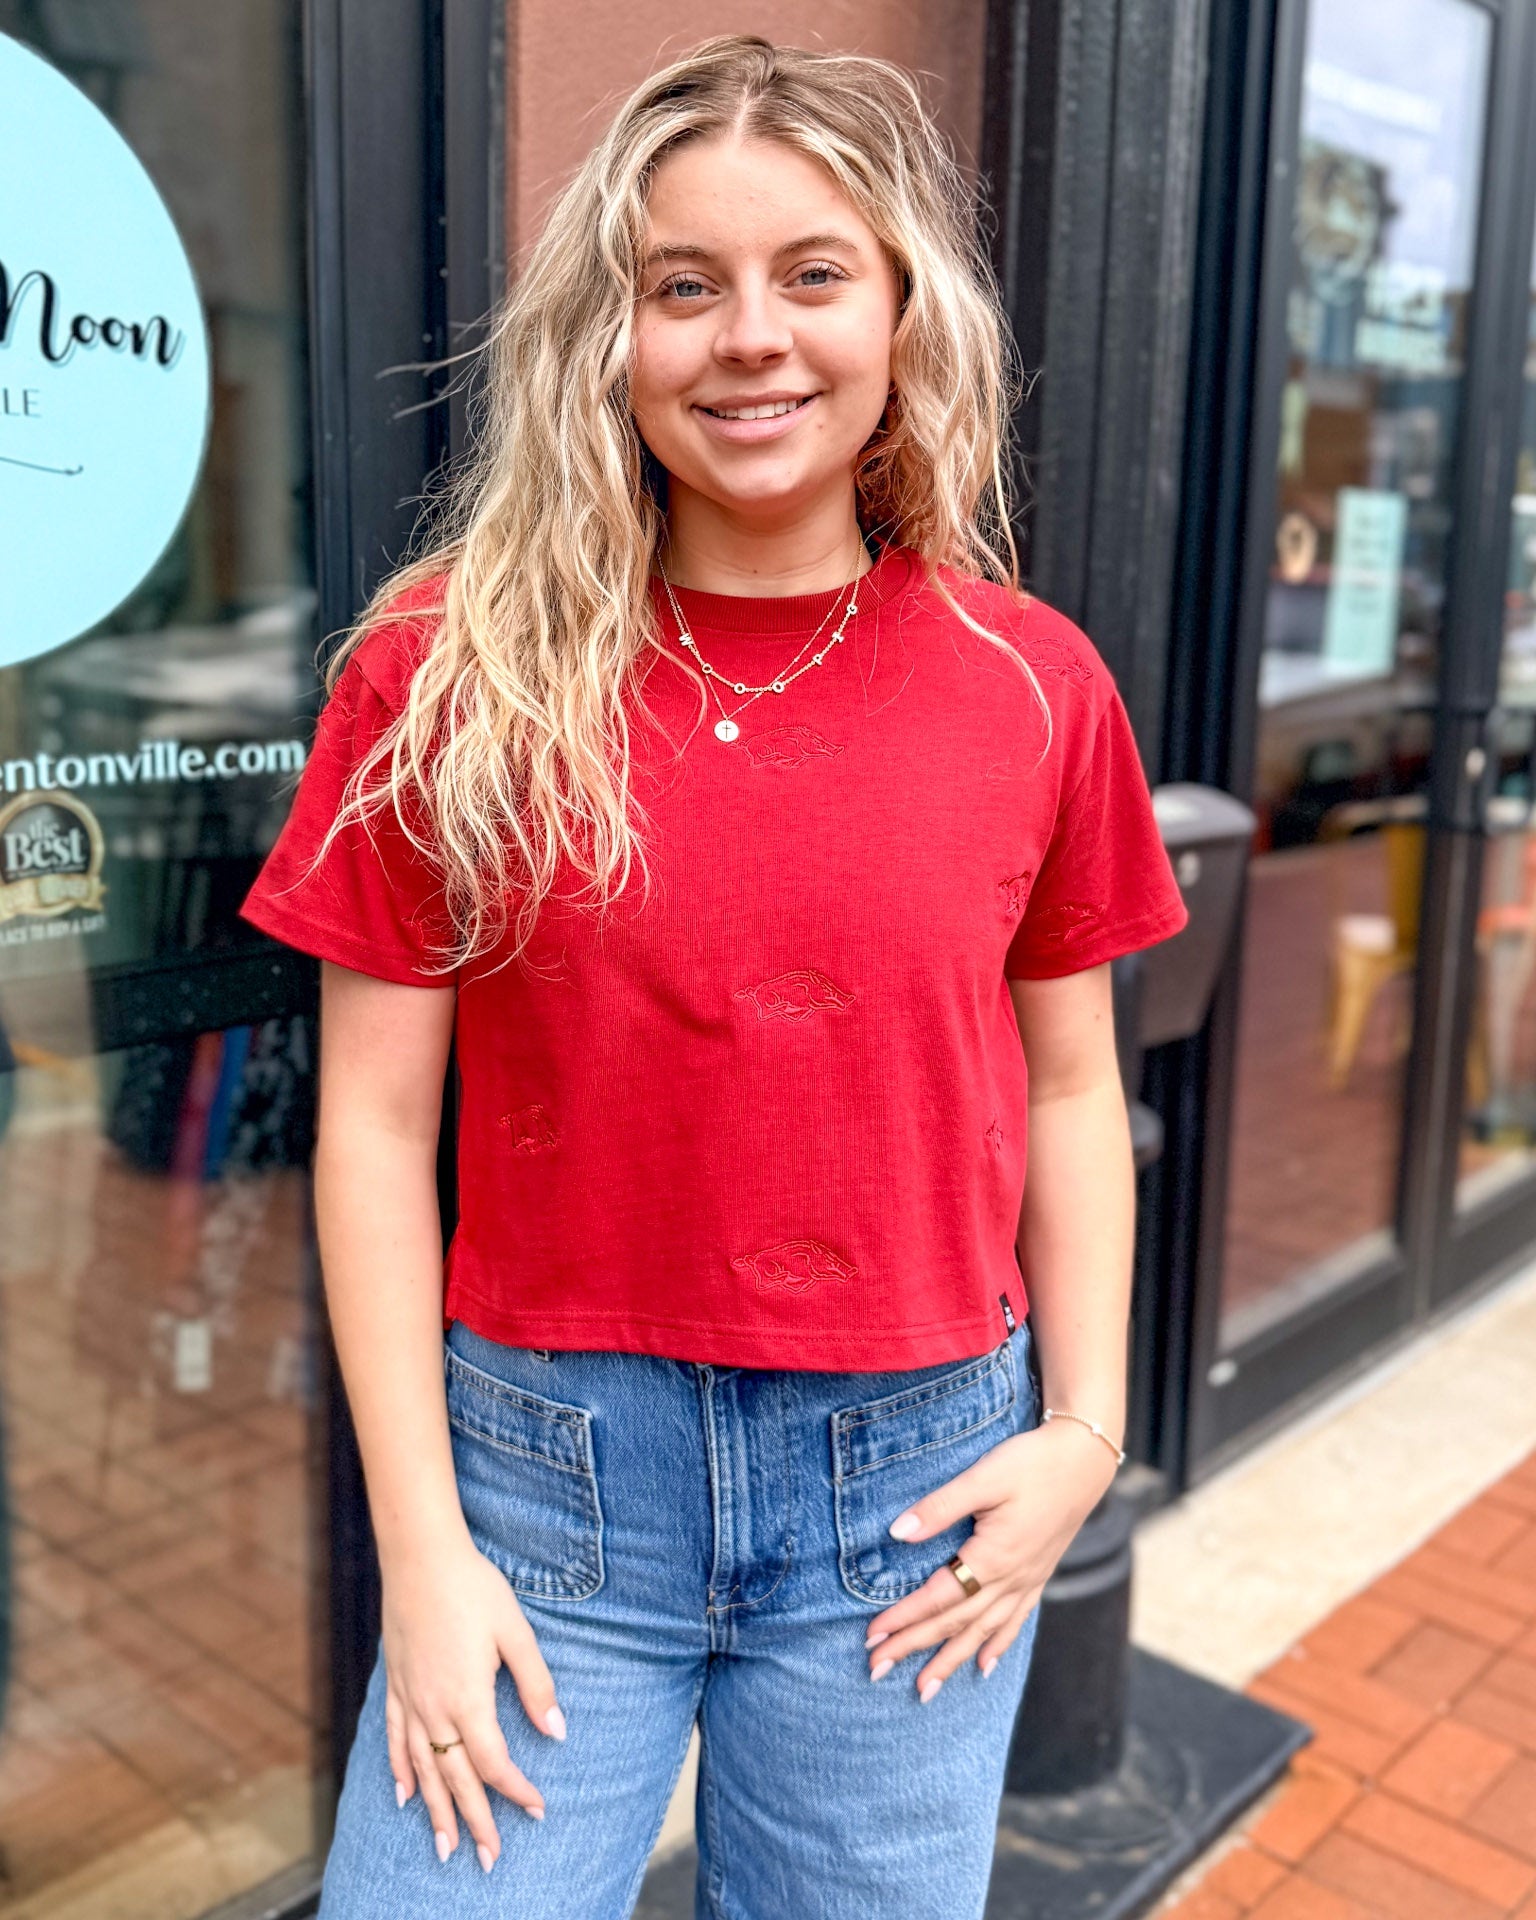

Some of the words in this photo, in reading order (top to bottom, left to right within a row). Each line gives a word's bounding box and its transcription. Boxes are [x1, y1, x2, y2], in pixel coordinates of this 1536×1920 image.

[0, 387, 41, 418] LE
[0, 740, 306, 792] ntonville.com
[29, 819, 59, 841] the
[4, 828, 86, 872] Best
